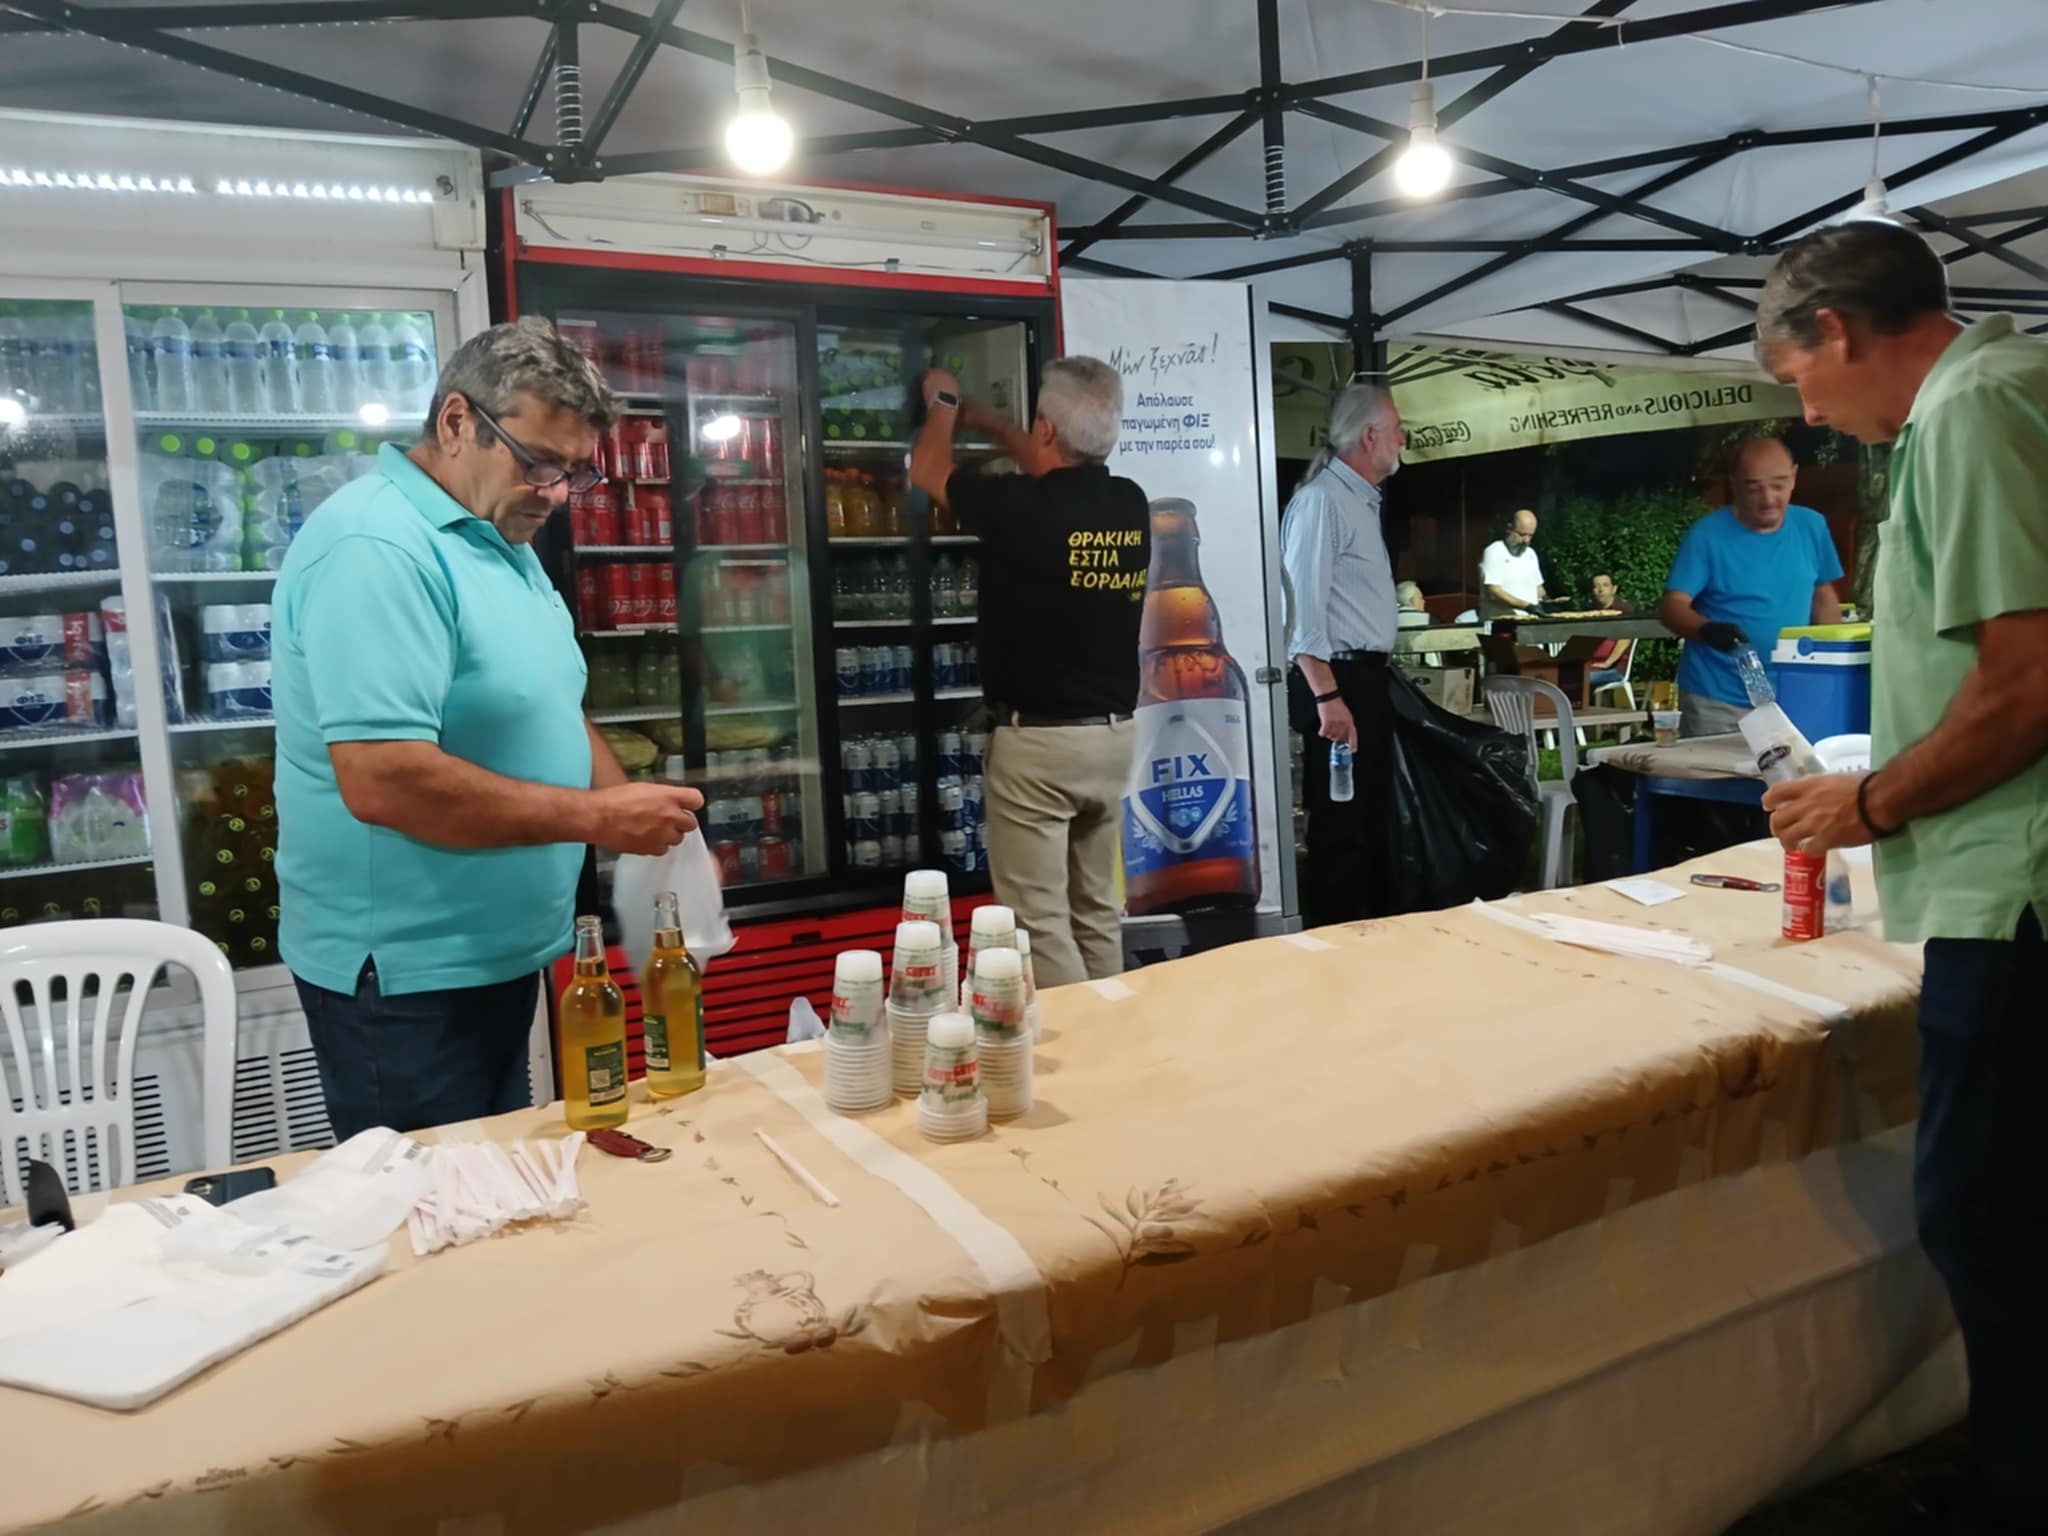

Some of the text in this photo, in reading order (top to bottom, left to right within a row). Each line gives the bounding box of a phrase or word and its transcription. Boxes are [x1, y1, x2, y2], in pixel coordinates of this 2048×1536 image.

[1136, 392, 1195, 408] Απόλαυσε
[1121, 413, 1211, 432] παγωμένη ΦΙΞ
[1119, 433, 1217, 456] με την παρέα σου!
[1067, 529, 1142, 548] ΘΡΑΚΙΚΗ
[1068, 550, 1119, 568] ΕΣΤΙΑ
[1151, 753, 1211, 783] FIX
[1161, 785, 1204, 803] HELLAS
